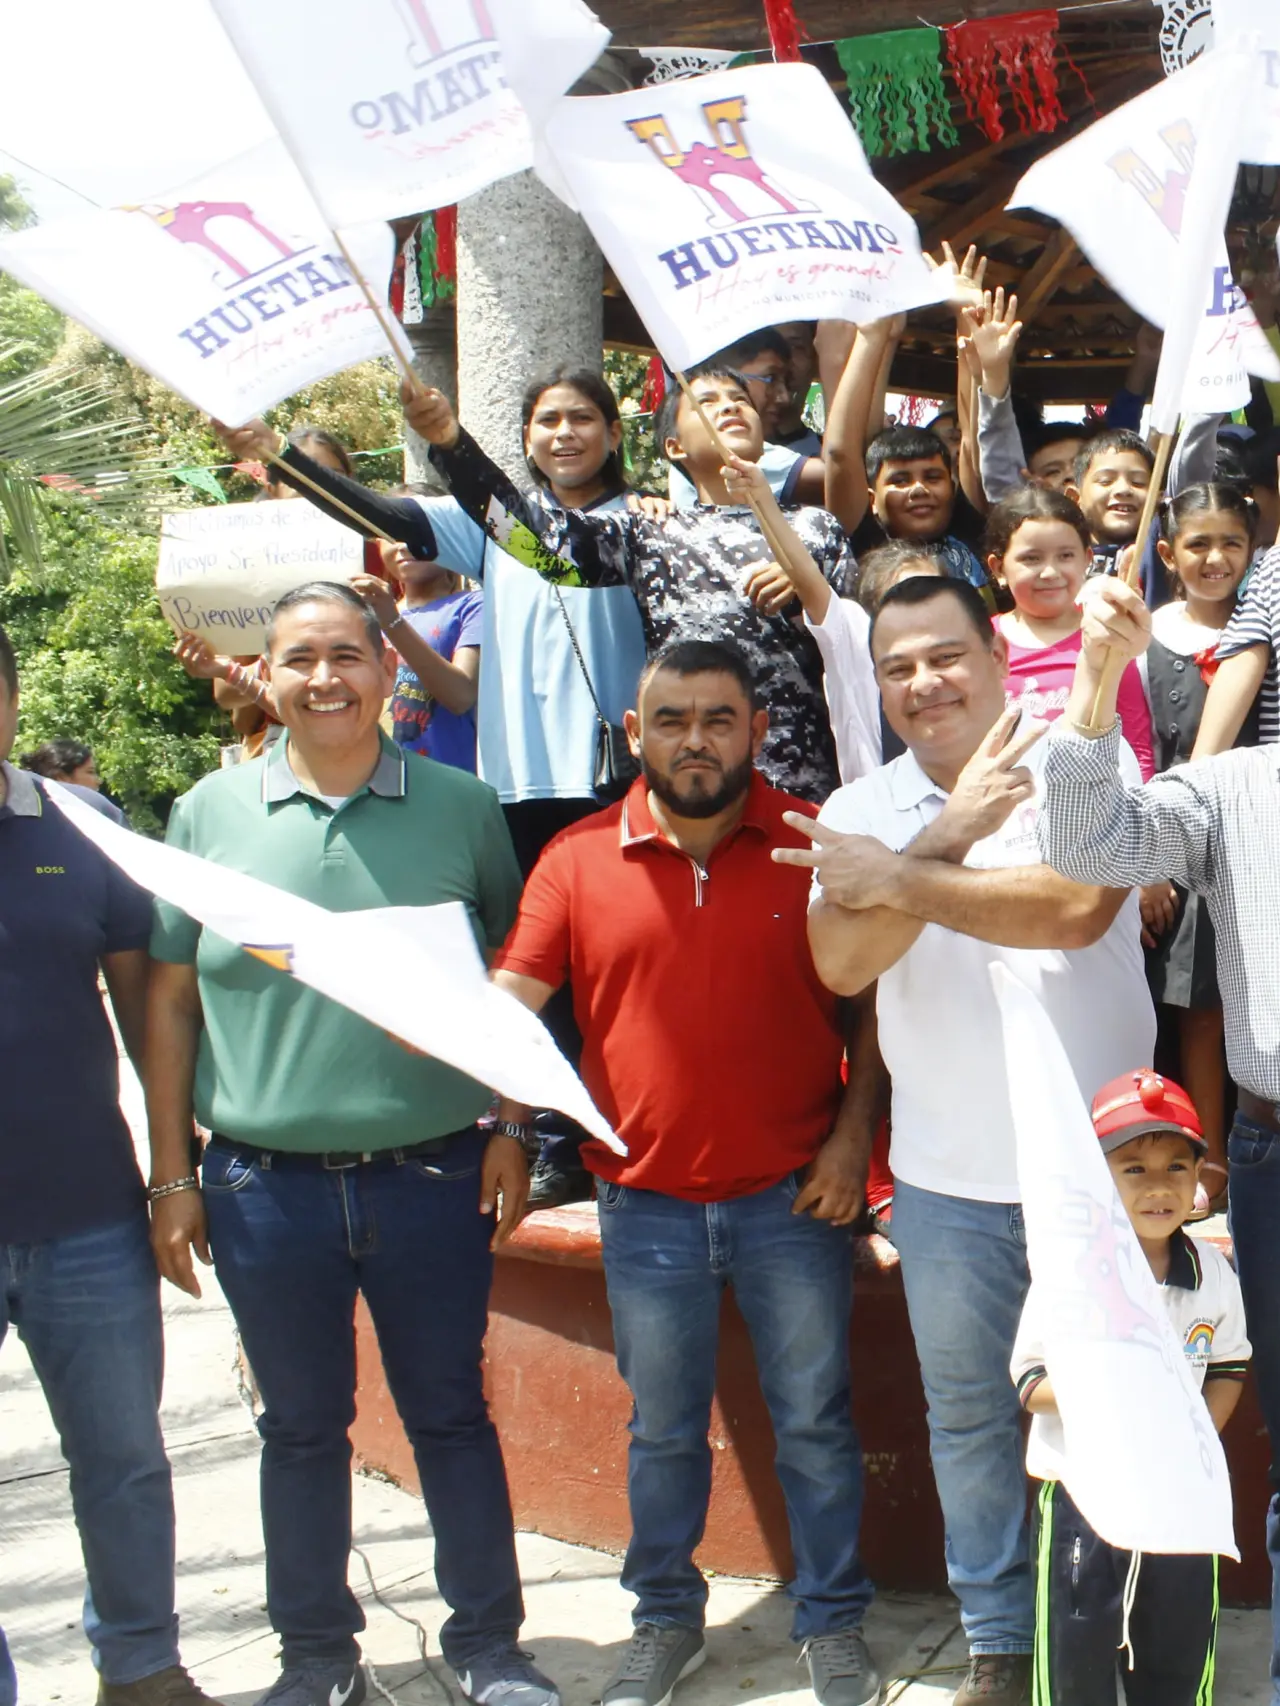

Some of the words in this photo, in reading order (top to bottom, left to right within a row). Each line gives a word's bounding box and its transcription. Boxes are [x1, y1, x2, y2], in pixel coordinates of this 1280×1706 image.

[657, 219, 898, 290] HUETAMO
[166, 551, 219, 579] Apoyo
[227, 544, 256, 571] Sr.
[262, 535, 363, 567] Presidente
[35, 866, 66, 874] BOSS
